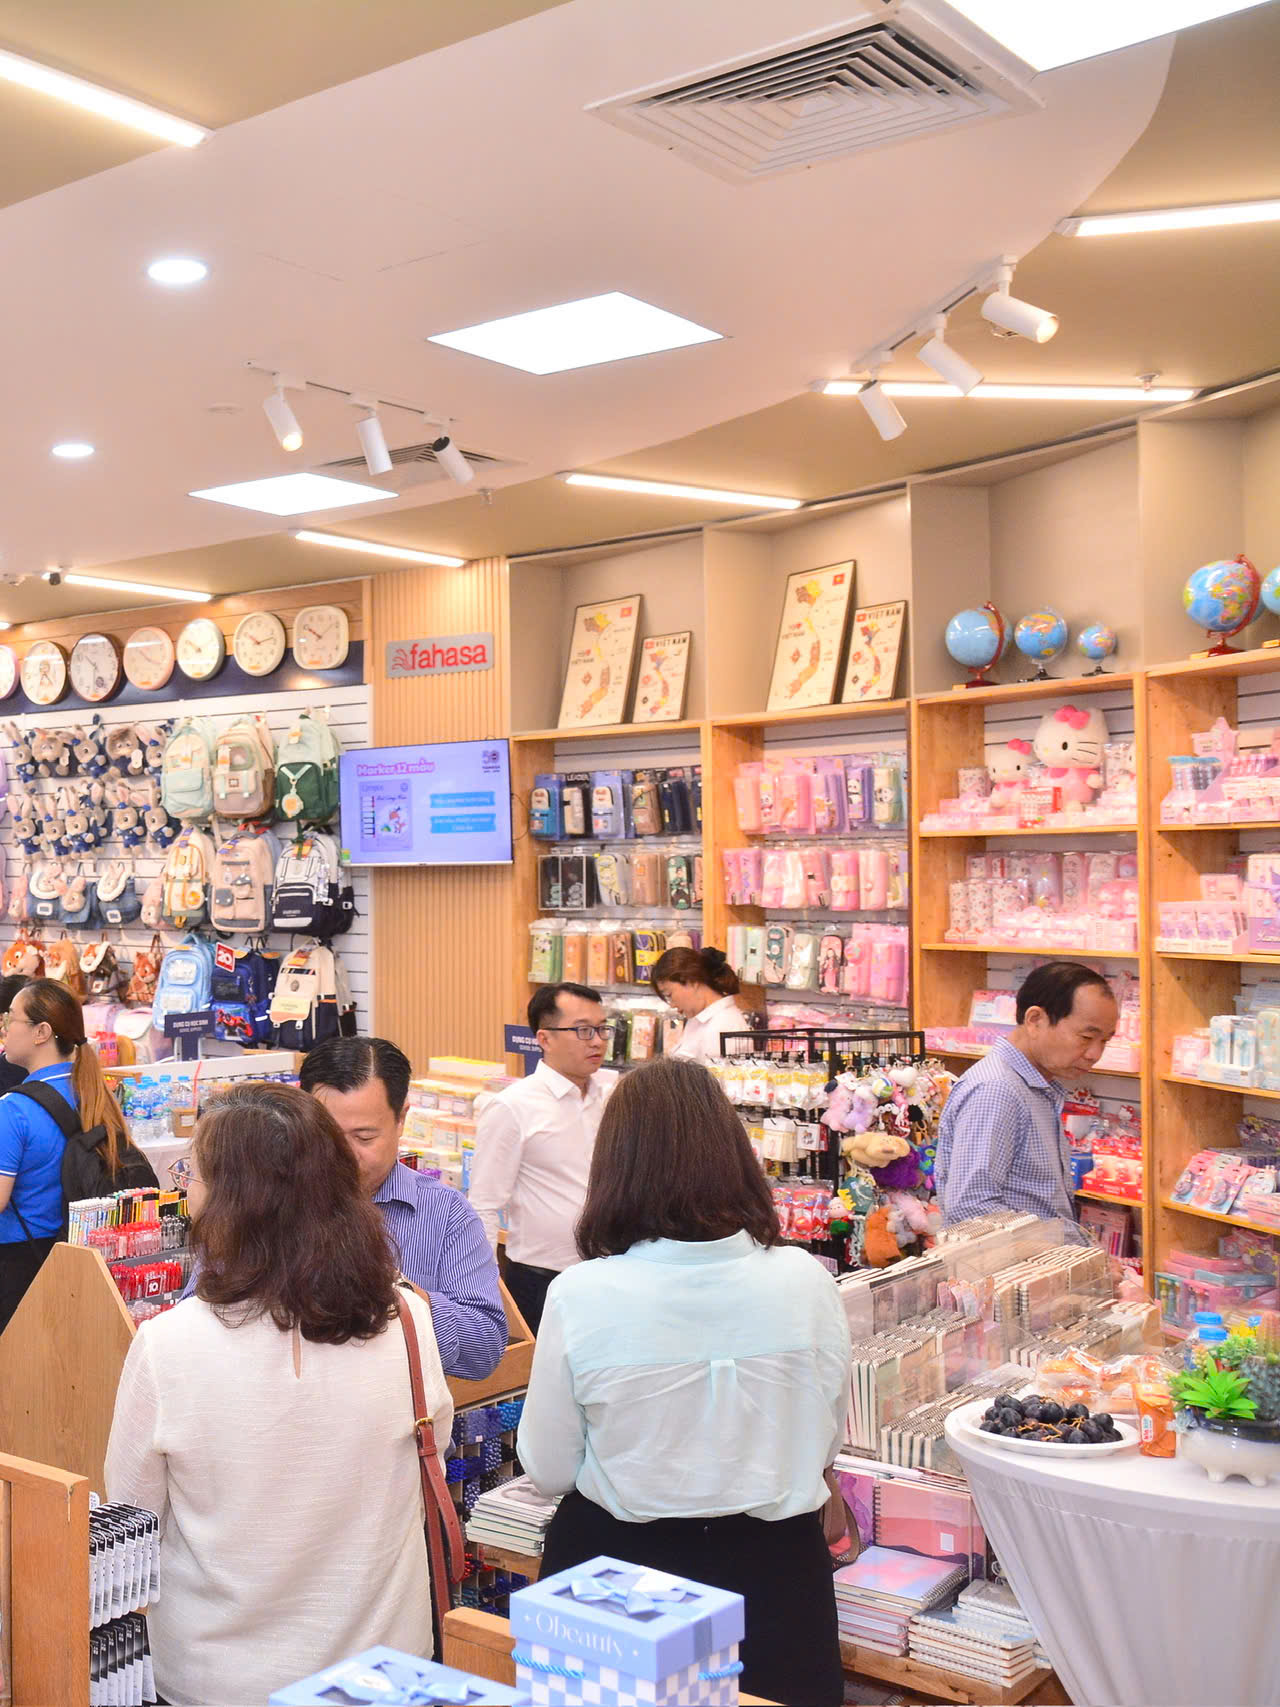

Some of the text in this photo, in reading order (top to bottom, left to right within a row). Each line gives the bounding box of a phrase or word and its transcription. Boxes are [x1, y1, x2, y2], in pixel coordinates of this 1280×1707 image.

[409, 643, 488, 670] fahasa
[357, 763, 394, 776] Marker
[395, 762, 407, 774] 12
[217, 950, 234, 965] 20
[148, 1282, 158, 1292] 10
[535, 1612, 624, 1657] Obeauty
